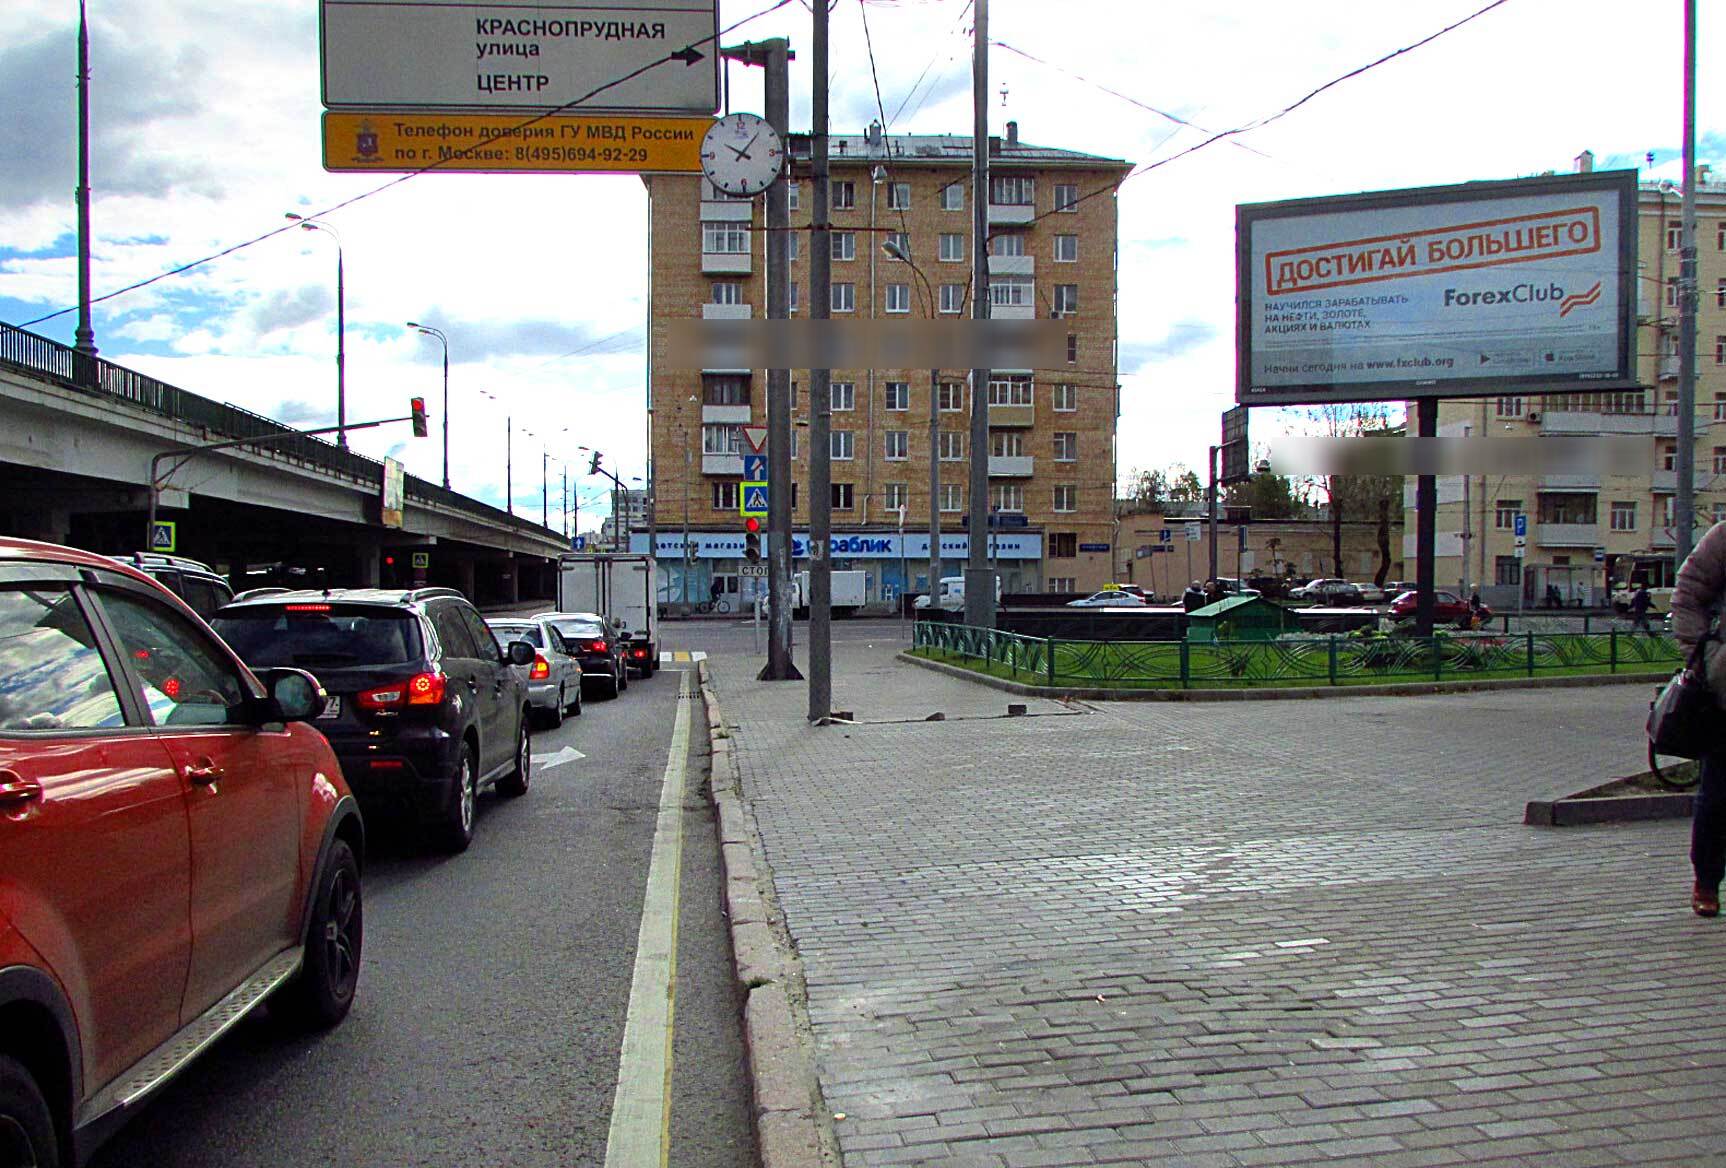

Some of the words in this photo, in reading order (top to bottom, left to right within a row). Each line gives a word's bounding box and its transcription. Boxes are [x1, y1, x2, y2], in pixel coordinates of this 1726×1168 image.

[476, 18, 665, 41] КРАСНОПРУДНАЯ
[476, 42, 540, 59] улица
[477, 74, 549, 94] ЦЕНТР
[393, 122, 473, 140] Телефон
[478, 126, 555, 141] доверия
[560, 124, 581, 139] ГУ
[586, 125, 627, 142] МВД
[631, 126, 694, 141] России
[394, 148, 417, 160] по
[422, 149, 433, 160] г.
[438, 145, 509, 161] Москве:
[515, 146, 648, 162] 8(495)694-92-29
[710, 151, 716, 160] 9
[769, 149, 776, 157] 3
[741, 178, 748, 187] 6
[1277, 238, 1416, 289] ДОСТИГАЙ
[1427, 220, 1589, 264] БОЛЬШЕГО
[1443, 283, 1564, 307] ForexClub
[1264, 313, 1279, 323] НА
[1264, 322, 1307, 335] АКЦИЯХ
[1309, 321, 1318, 332] И
[1264, 363, 1299, 375] Начни
[807, 535, 892, 553] раблик
[921, 542, 968, 551] дский
